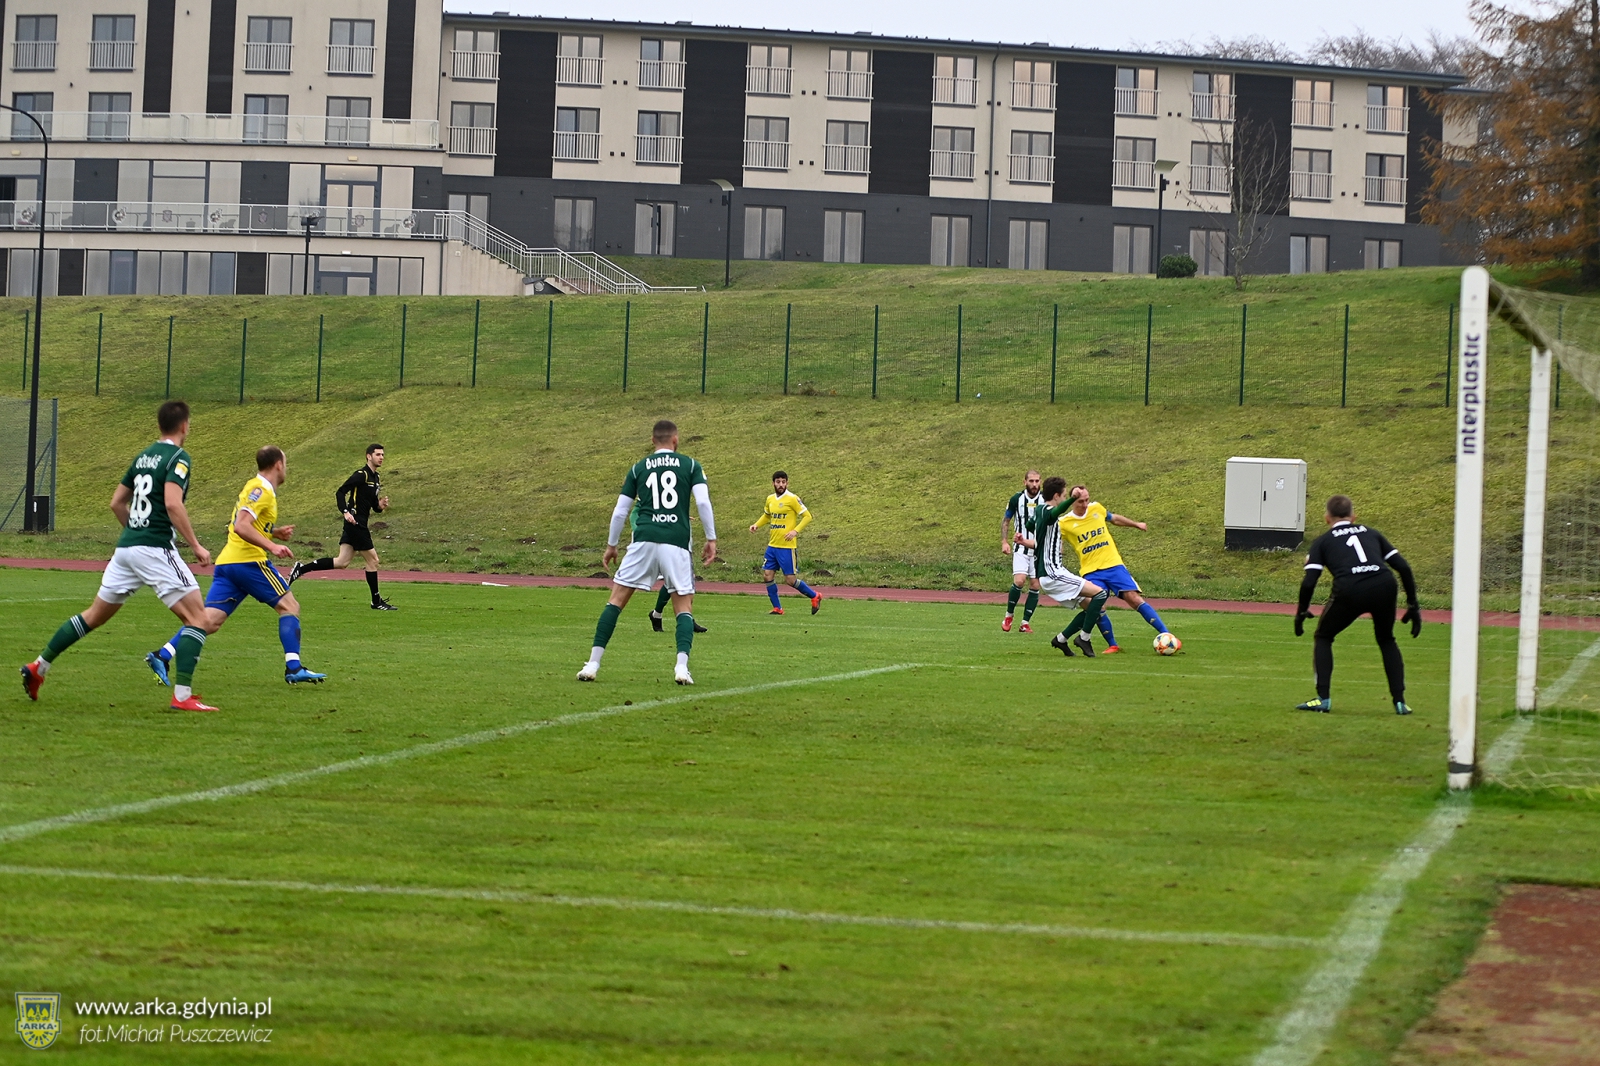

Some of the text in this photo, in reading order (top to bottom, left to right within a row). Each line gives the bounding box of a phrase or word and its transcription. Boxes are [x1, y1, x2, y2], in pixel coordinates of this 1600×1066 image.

[1461, 332, 1481, 455] interplastic
[645, 470, 679, 510] 18
[1345, 534, 1368, 563] 1
